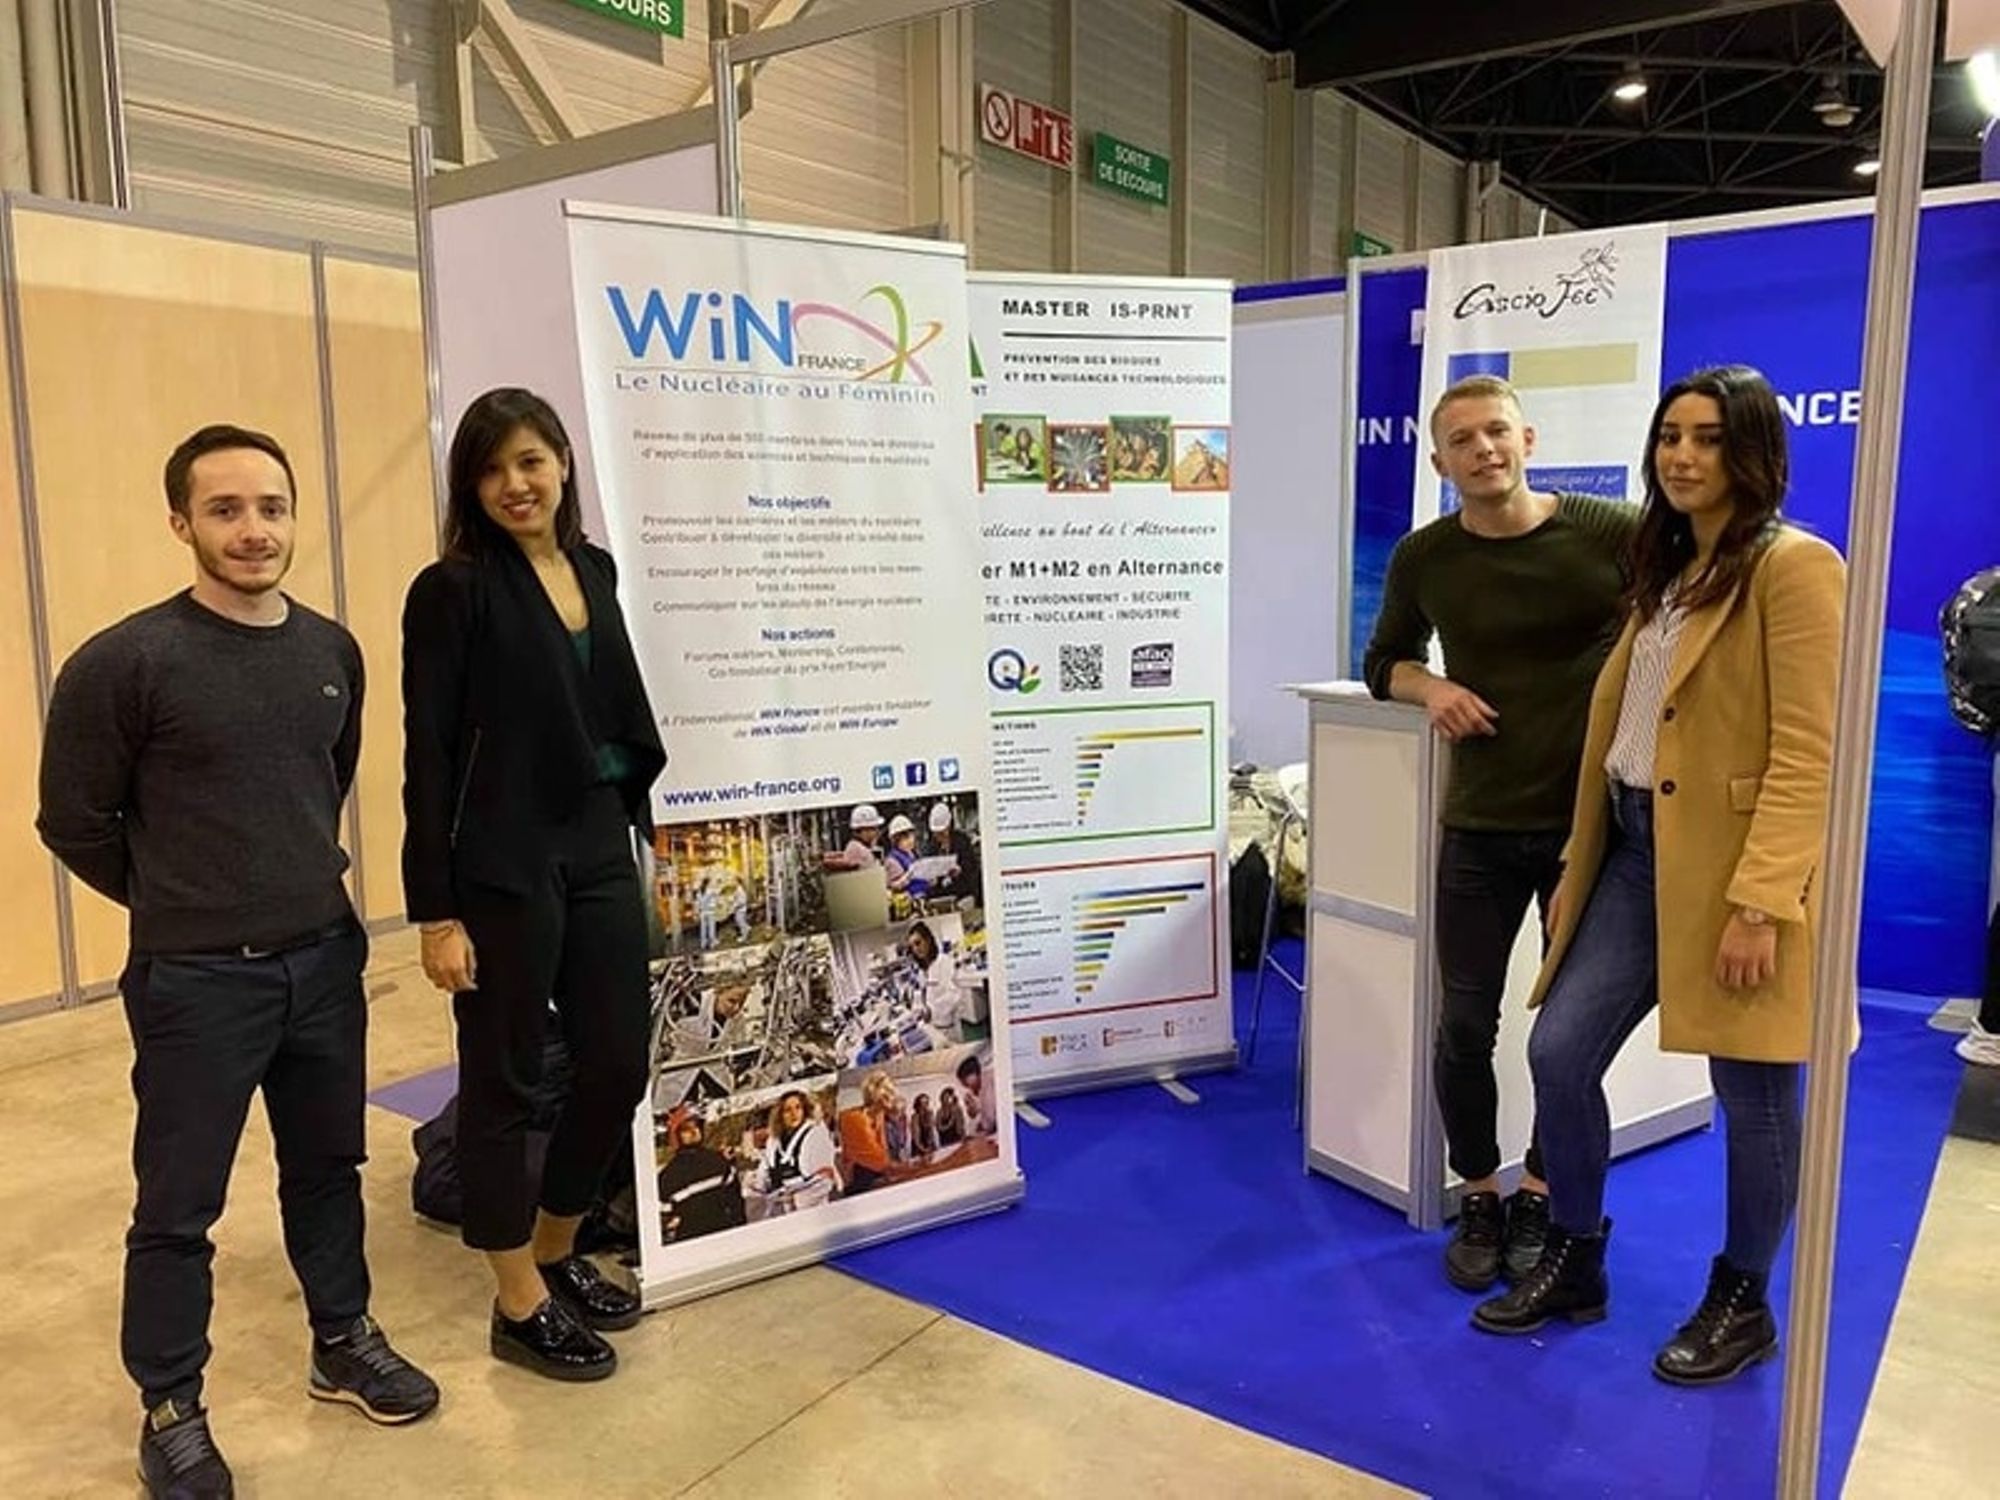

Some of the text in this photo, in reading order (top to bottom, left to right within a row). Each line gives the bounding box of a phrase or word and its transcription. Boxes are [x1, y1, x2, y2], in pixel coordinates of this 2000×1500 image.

[1116, 168, 1163, 199] SECOURS
[1002, 299, 1193, 320] MASTER IS-PRNT
[606, 286, 795, 367] WiN
[798, 353, 866, 372] FRANCE
[615, 372, 936, 404] Le Nucléaire au Féminin
[1775, 389, 1861, 427] NCE
[748, 495, 831, 512] Nos objectifs
[981, 559, 1224, 579] er M1+M2 en Alternance
[1013, 592, 1120, 605] ENVIRONNEMENT
[1116, 607, 1181, 620] INDUSTRIE
[761, 627, 836, 641] Nos actions
[663, 776, 842, 807] www.win-france.org
